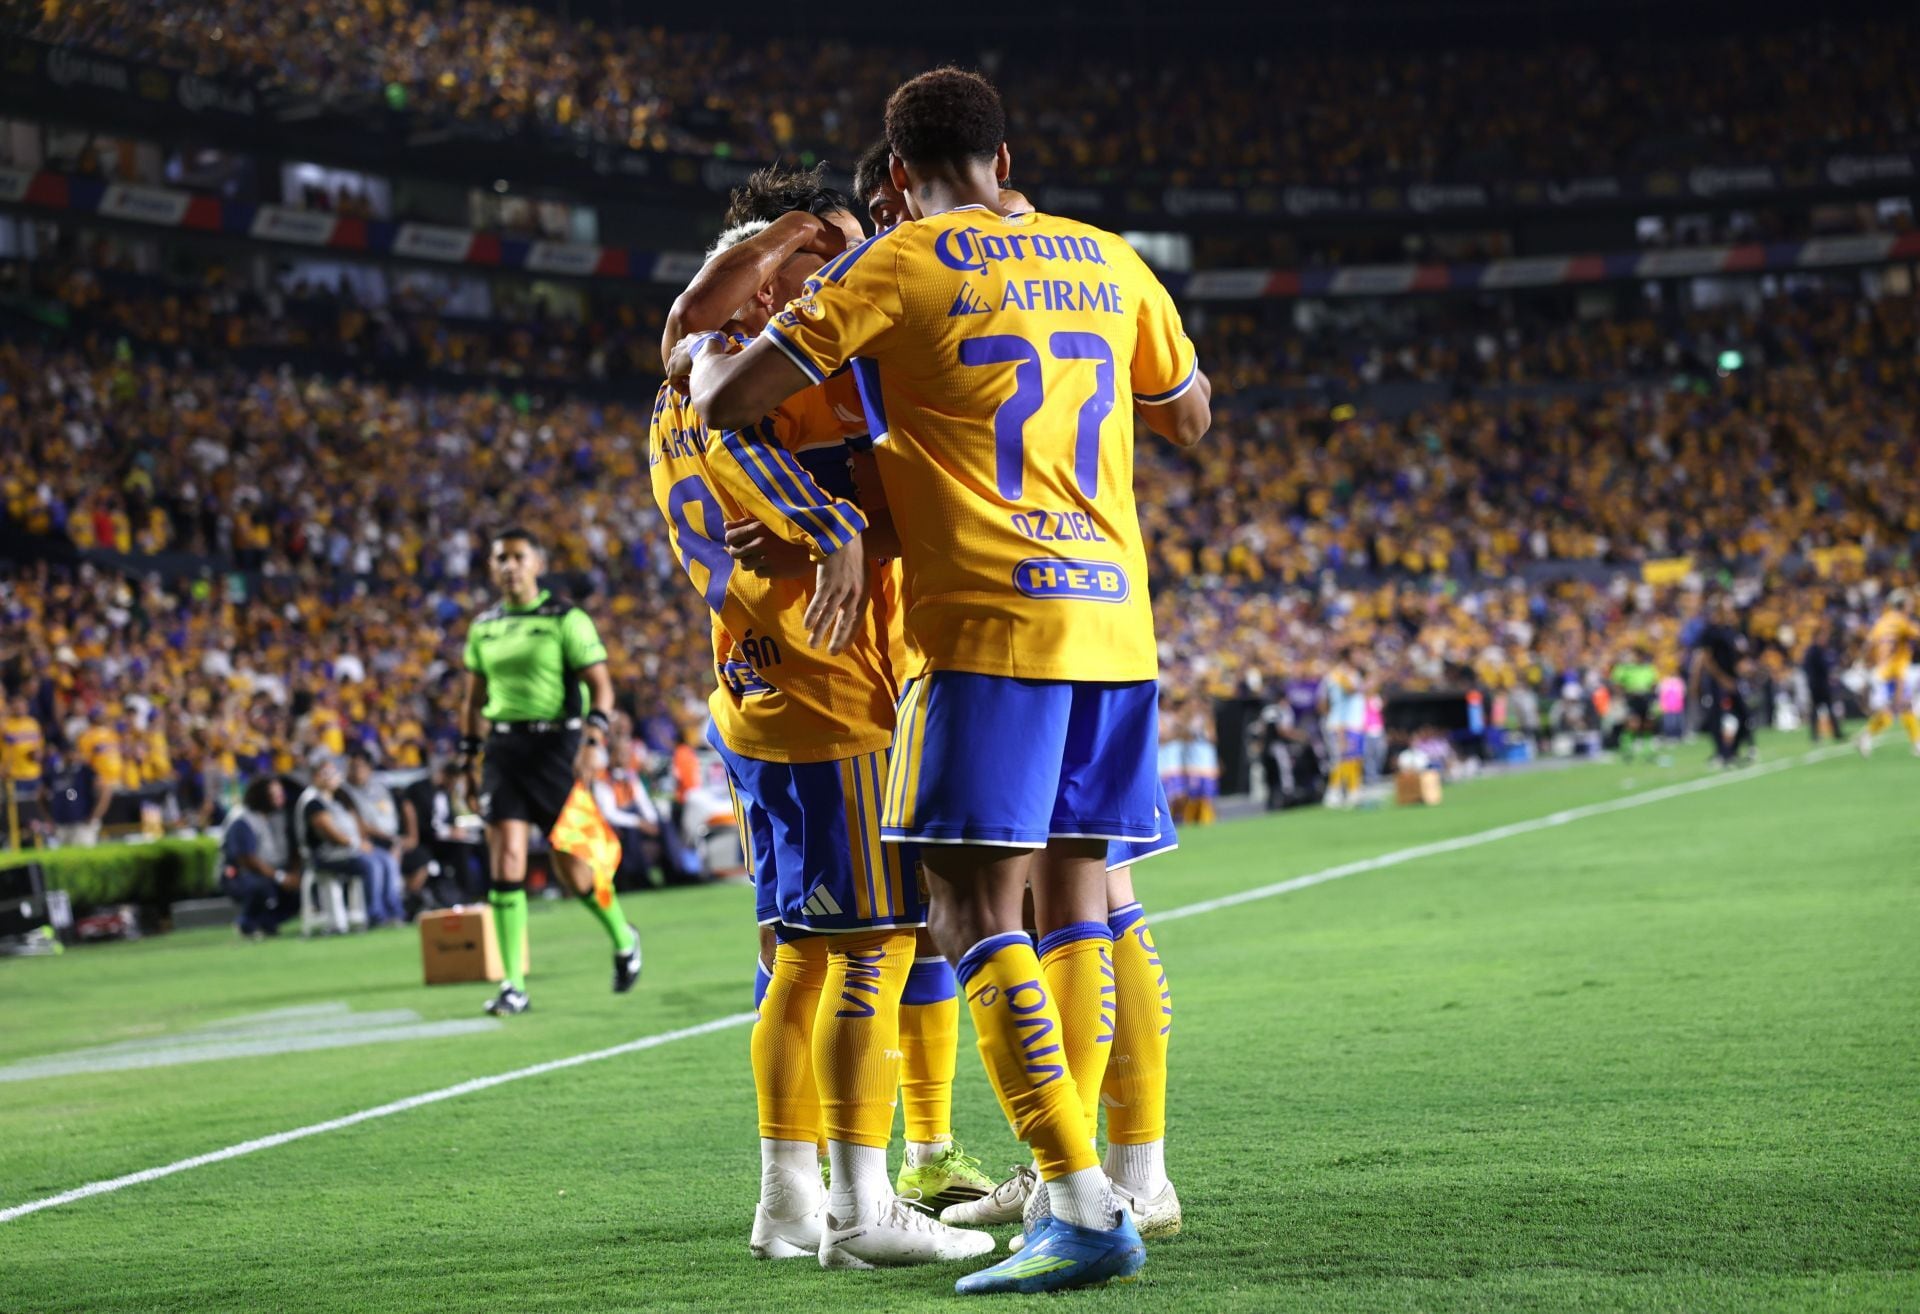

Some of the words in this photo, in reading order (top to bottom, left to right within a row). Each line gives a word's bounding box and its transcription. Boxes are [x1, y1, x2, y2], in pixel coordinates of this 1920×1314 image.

[934, 226, 1108, 275] Corona
[1000, 279, 1124, 315] AFIRME
[958, 331, 1115, 500] 77
[668, 474, 735, 615] 8
[1010, 509, 1106, 542] OZZIEL
[1027, 565, 1121, 593] H-E-B
